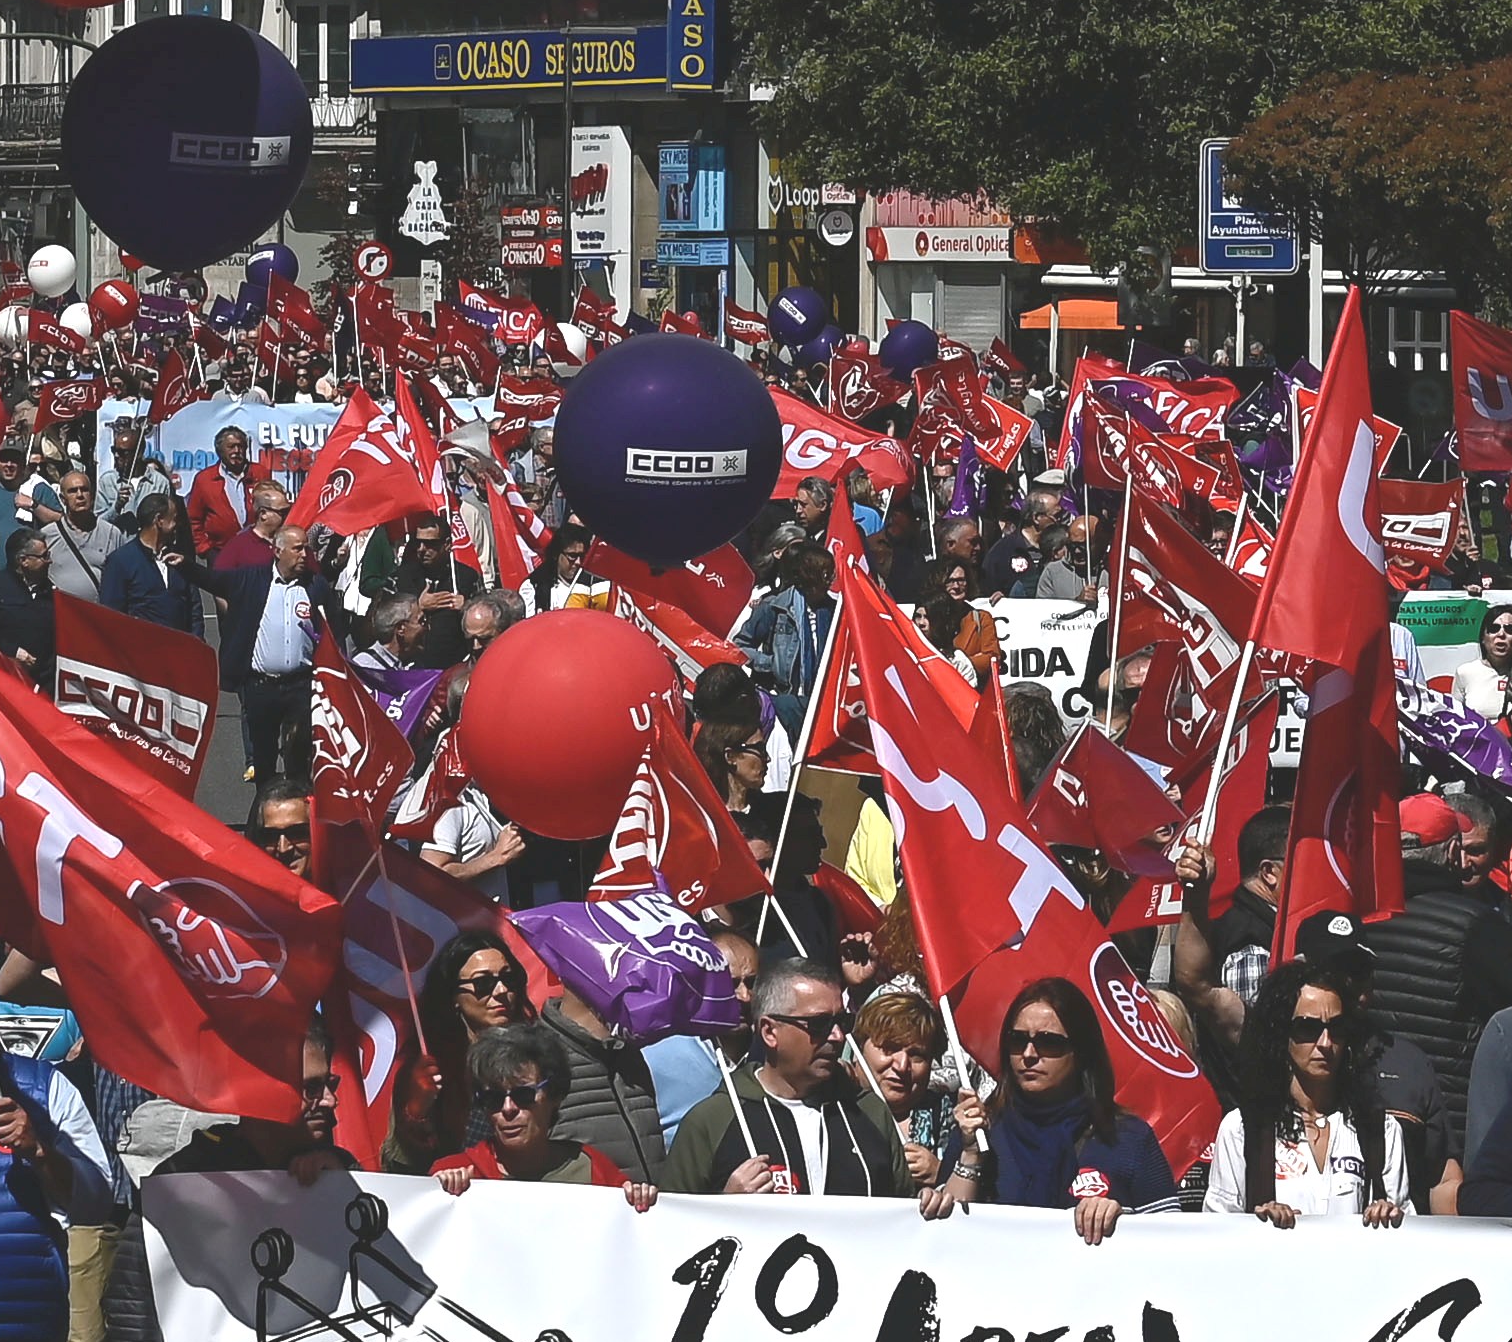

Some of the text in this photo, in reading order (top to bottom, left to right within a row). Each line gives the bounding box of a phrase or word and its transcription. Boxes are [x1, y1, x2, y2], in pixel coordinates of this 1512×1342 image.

[457, 39, 636, 79] OCASO SEGUROS
[178, 139, 259, 161] CCOO
[786, 188, 819, 209] Loop
[658, 242, 672, 257] SKY
[673, 242, 698, 257] MOBILE
[932, 235, 1009, 256] General Optica
[501, 311, 538, 333] ICA
[258, 422, 281, 446] EL
[632, 455, 715, 474] CCOO
[626, 478, 669, 487] comisiones
[672, 479, 701, 488] obreras
[630, 688, 675, 732] UT
